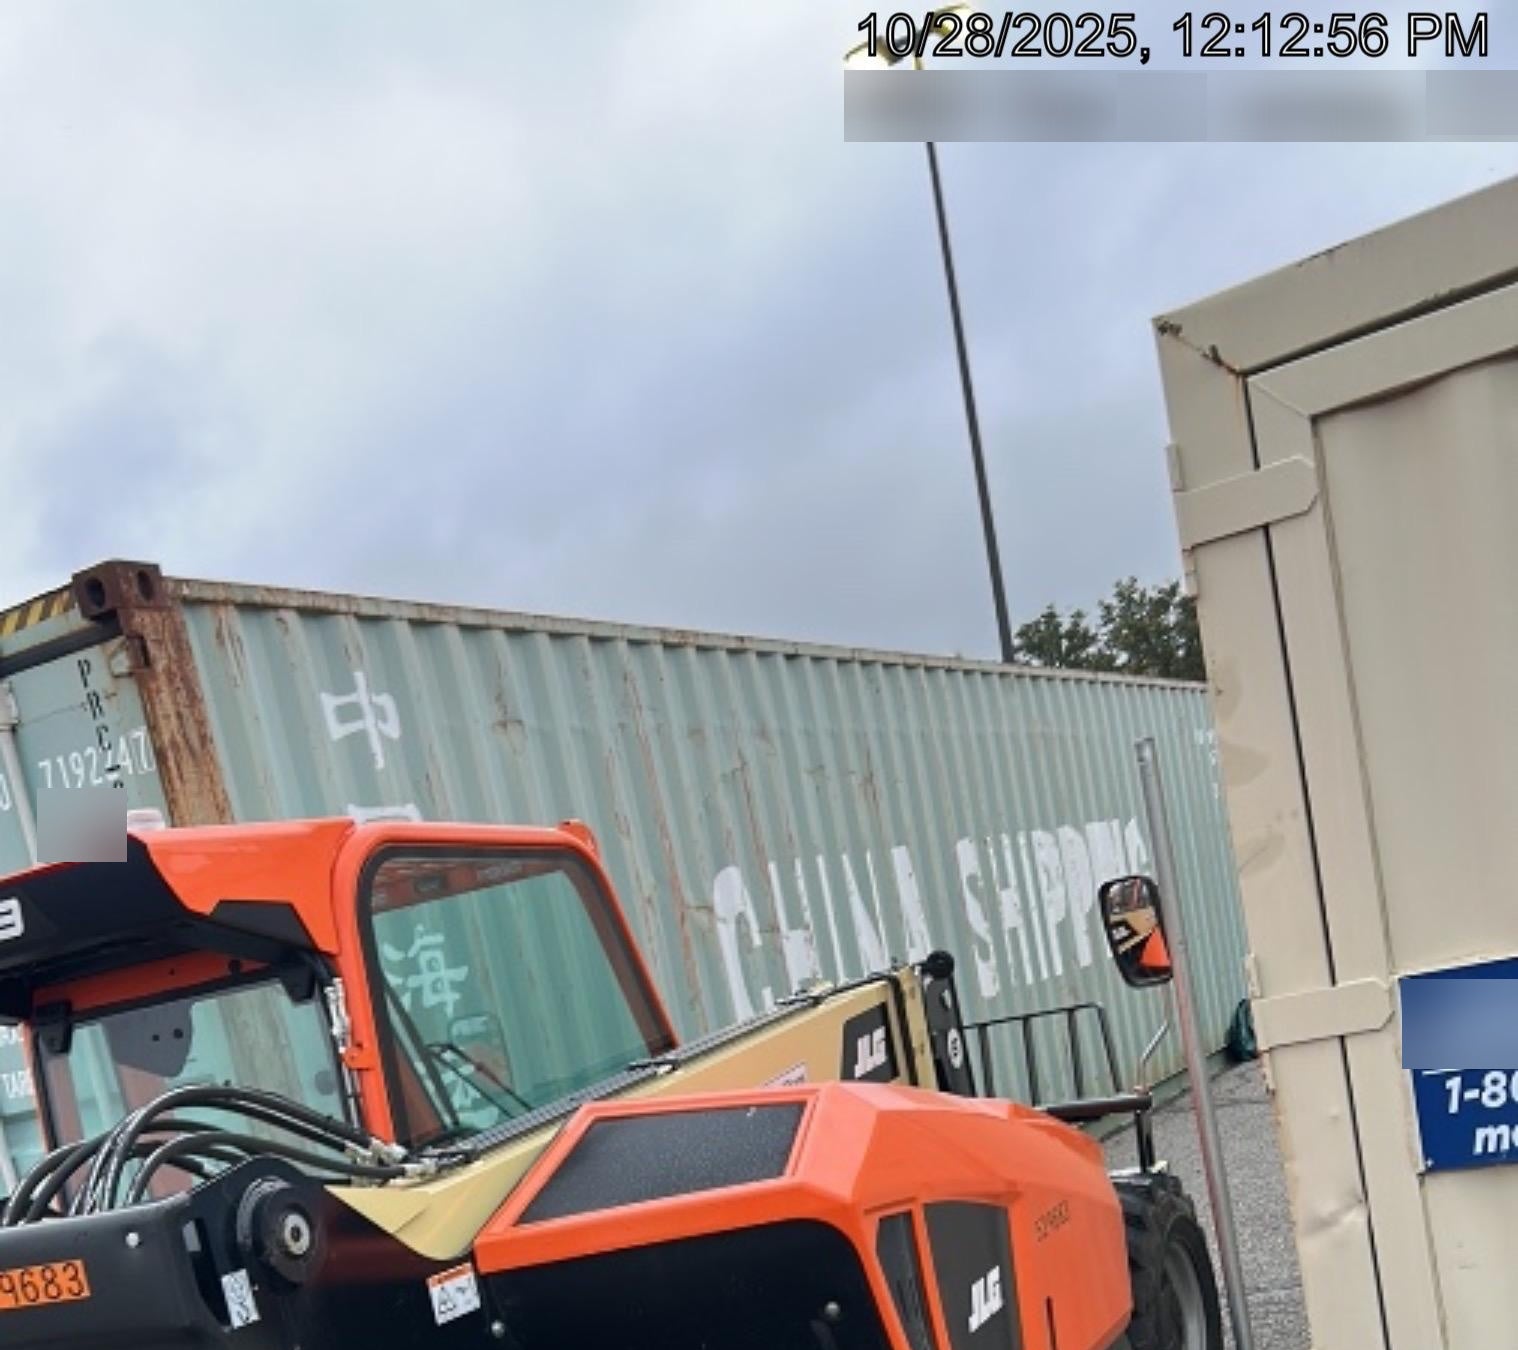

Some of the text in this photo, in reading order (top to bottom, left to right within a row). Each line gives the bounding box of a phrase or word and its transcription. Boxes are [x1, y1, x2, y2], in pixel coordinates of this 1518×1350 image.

[854, 1025, 886, 1079] JLG
[1446, 1071, 1518, 1114] 1-8
[1474, 1124, 1518, 1154] m
[968, 1265, 1003, 1333] JLG
